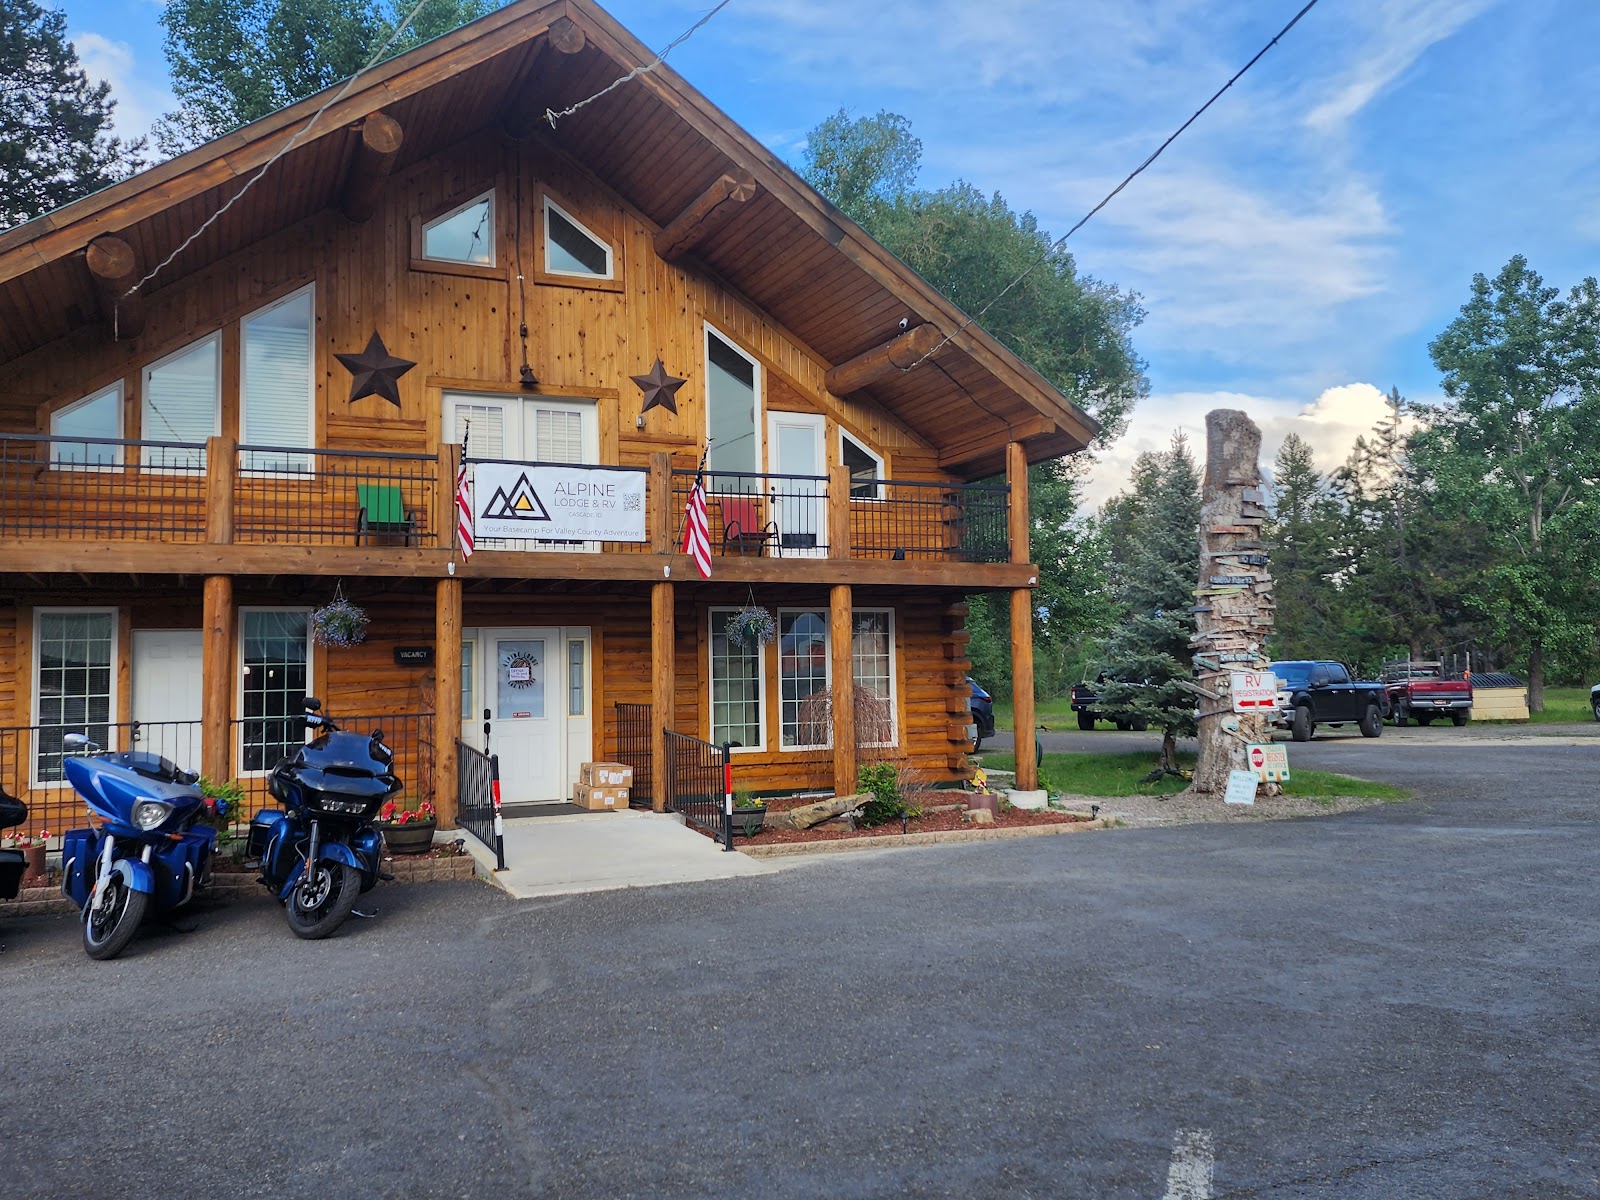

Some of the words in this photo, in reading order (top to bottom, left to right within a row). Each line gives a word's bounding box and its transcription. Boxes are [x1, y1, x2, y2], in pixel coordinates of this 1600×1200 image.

[554, 482, 616, 497] ALPINE
[554, 498, 590, 508] LODGE
[592, 499, 600, 508] &
[603, 499, 617, 509] RV
[483, 525, 502, 533] Your
[503, 526, 540, 535] Basecamp
[555, 527, 576, 536] Valley
[577, 528, 602, 537] County
[603, 529, 639, 537] Adventure
[503, 652, 520, 667] ALPINE
[523, 652, 539, 666] LODGE
[1245, 675, 1262, 688] RV
[1235, 689, 1275, 698] REGISTRATION
[1251, 753, 1264, 763] STOP
[1267, 752, 1285, 762] REGISTER
